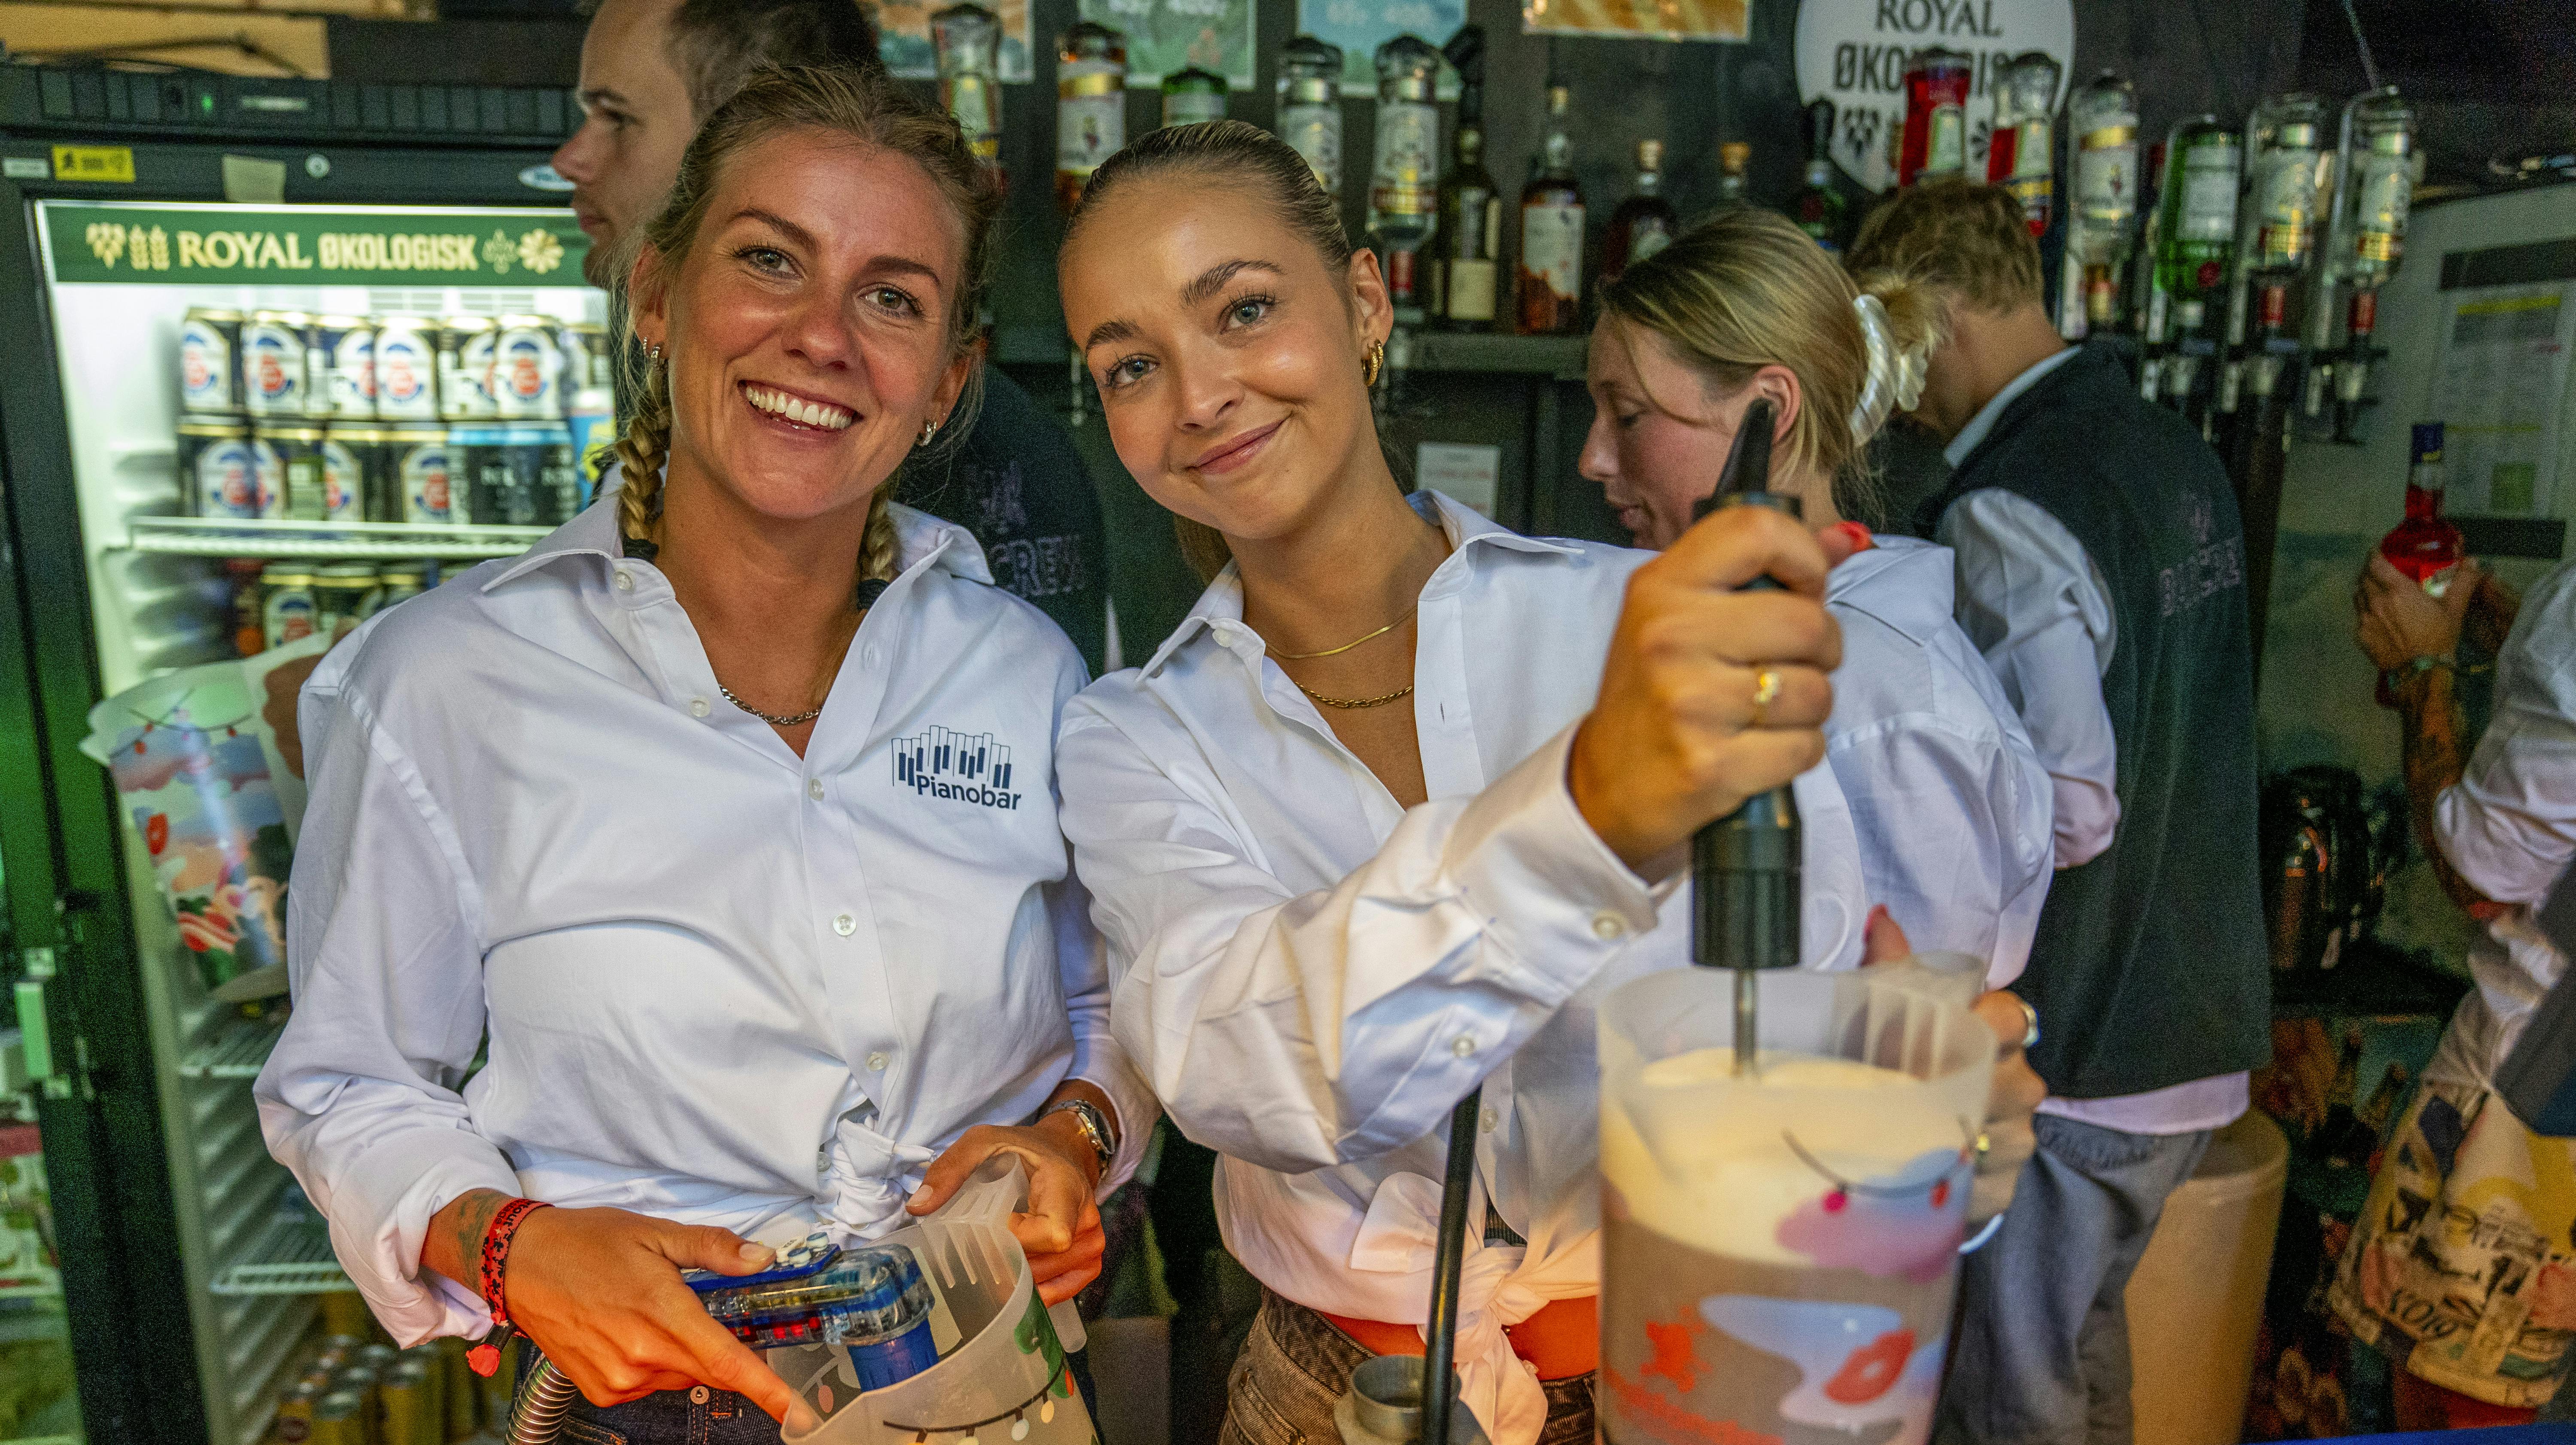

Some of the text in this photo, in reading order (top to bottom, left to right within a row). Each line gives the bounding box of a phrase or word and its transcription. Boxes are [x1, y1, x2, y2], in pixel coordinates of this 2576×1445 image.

[1874, 0, 2004, 37] ROYAL
[176, 231, 479, 271] ROYAL ØKOLOGISK
[916, 774, 1021, 810] Pianobar
